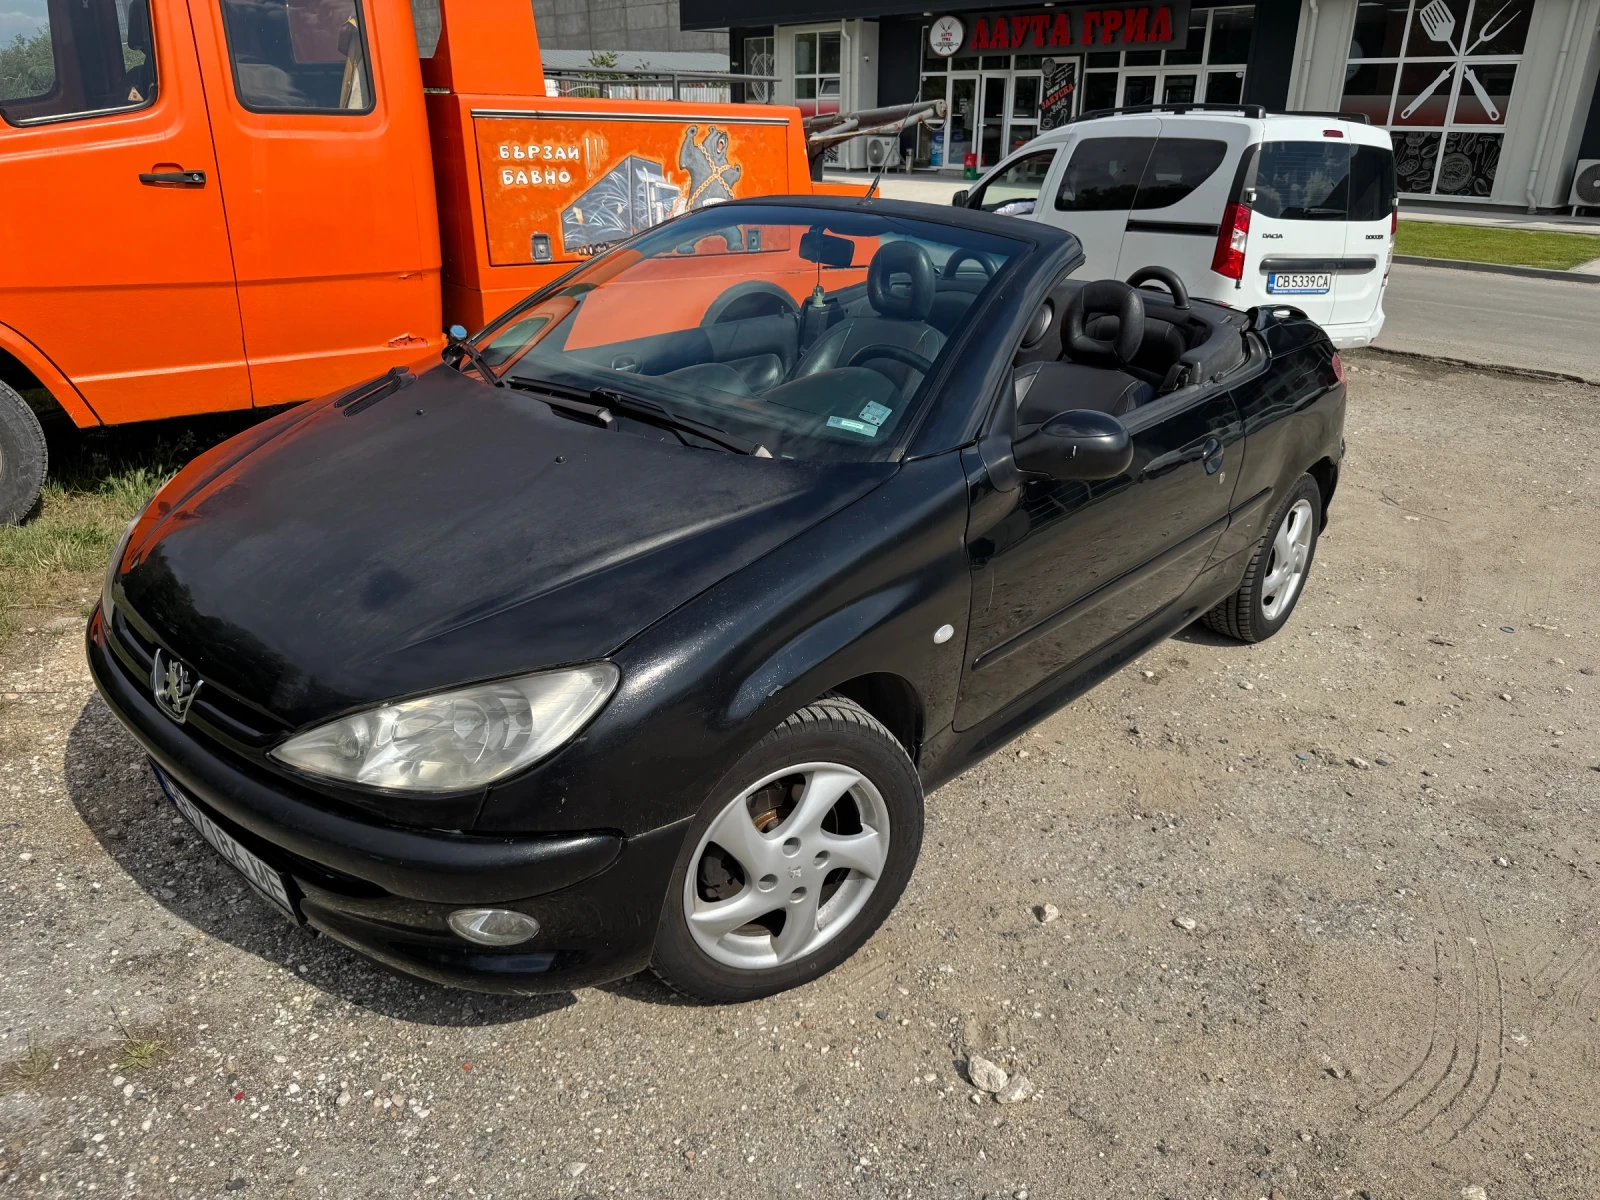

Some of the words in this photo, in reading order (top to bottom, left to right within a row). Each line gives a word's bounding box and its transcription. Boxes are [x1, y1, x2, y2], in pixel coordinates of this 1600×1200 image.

[970, 13, 1071, 49] ЛАУТА
[1081, 7, 1172, 45] ГРИЛ
[1041, 83, 1075, 110] ЗАКУСКА
[502, 168, 571, 185] БАВНО
